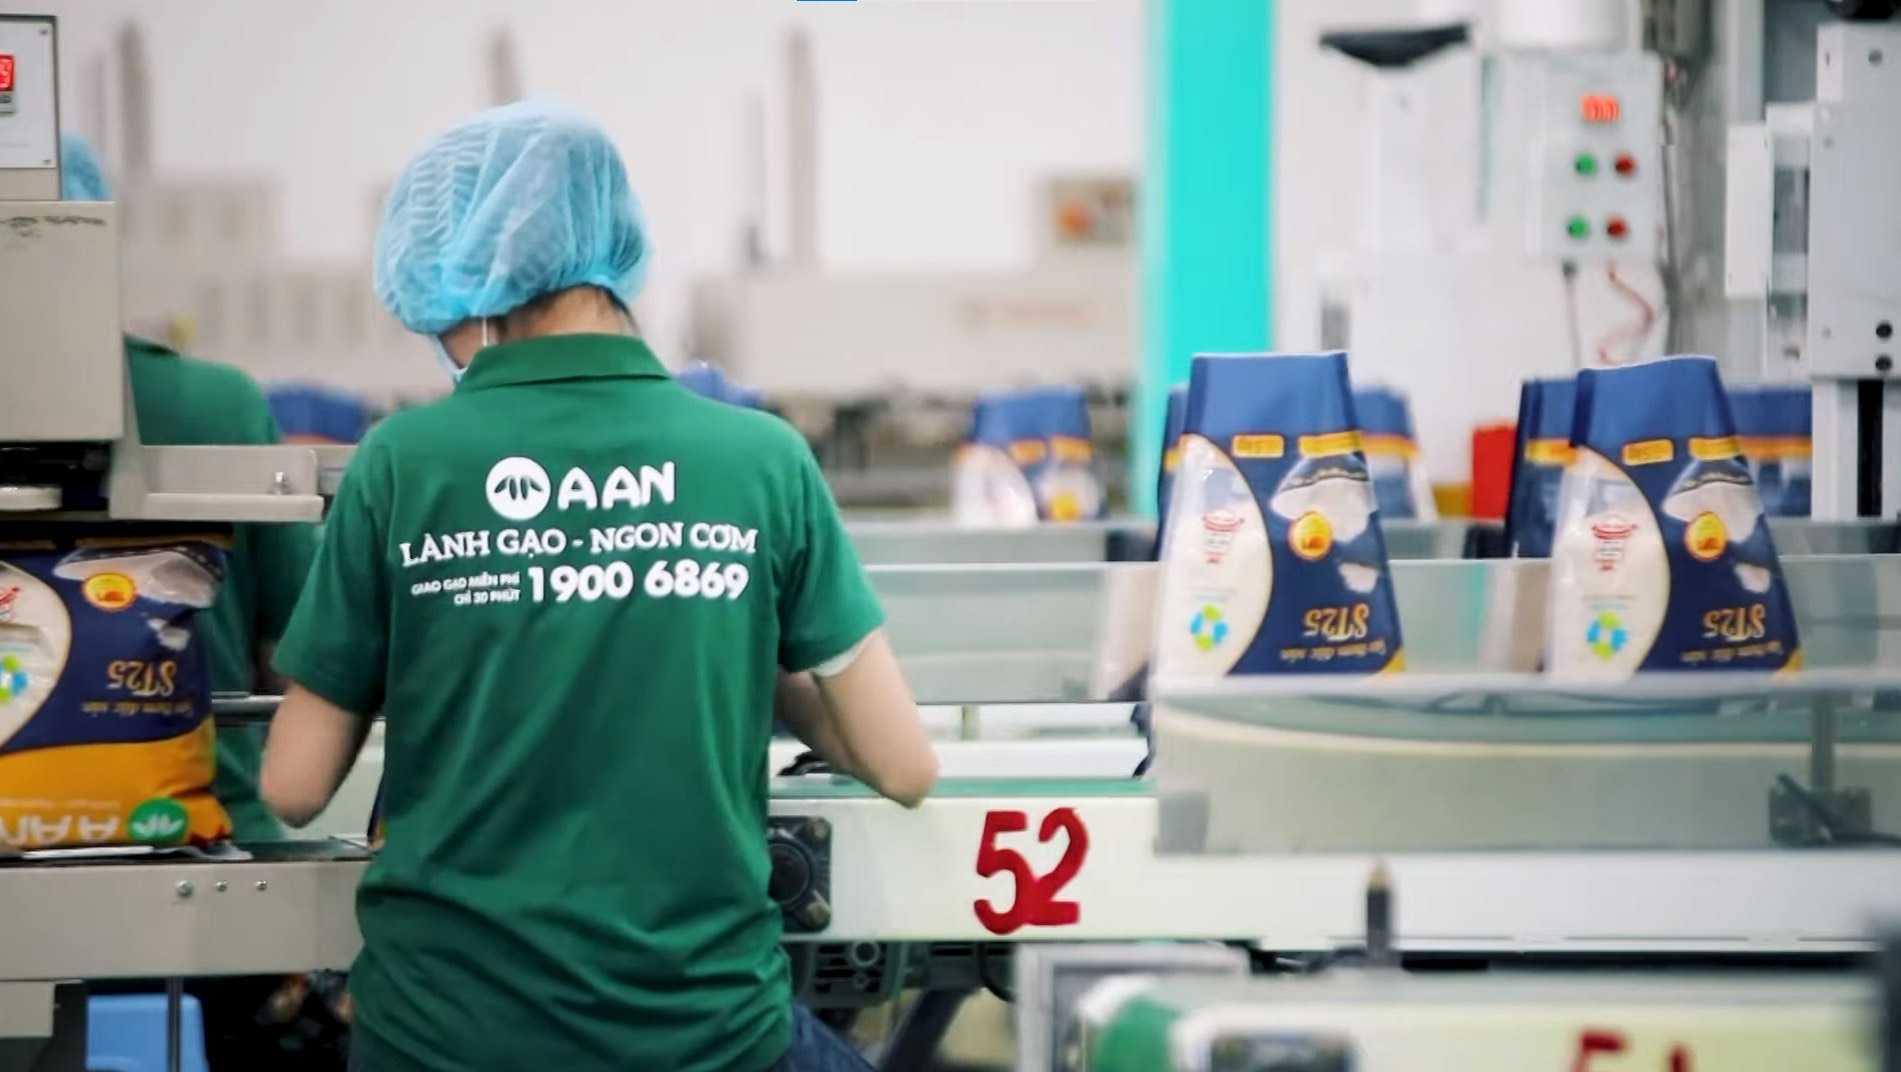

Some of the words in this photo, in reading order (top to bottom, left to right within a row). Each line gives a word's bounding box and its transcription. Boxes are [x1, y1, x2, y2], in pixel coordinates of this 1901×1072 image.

[497, 528, 567, 559] GẠO
[590, 522, 684, 554] NGON
[690, 522, 758, 553] CƠM
[411, 579, 442, 595] GIAO
[528, 561, 633, 601] 1900
[644, 559, 749, 599] 6869
[1304, 603, 1370, 642] ST25
[1703, 603, 1767, 642] ST25
[107, 659, 177, 697] ST25
[973, 807, 1090, 936] 52
